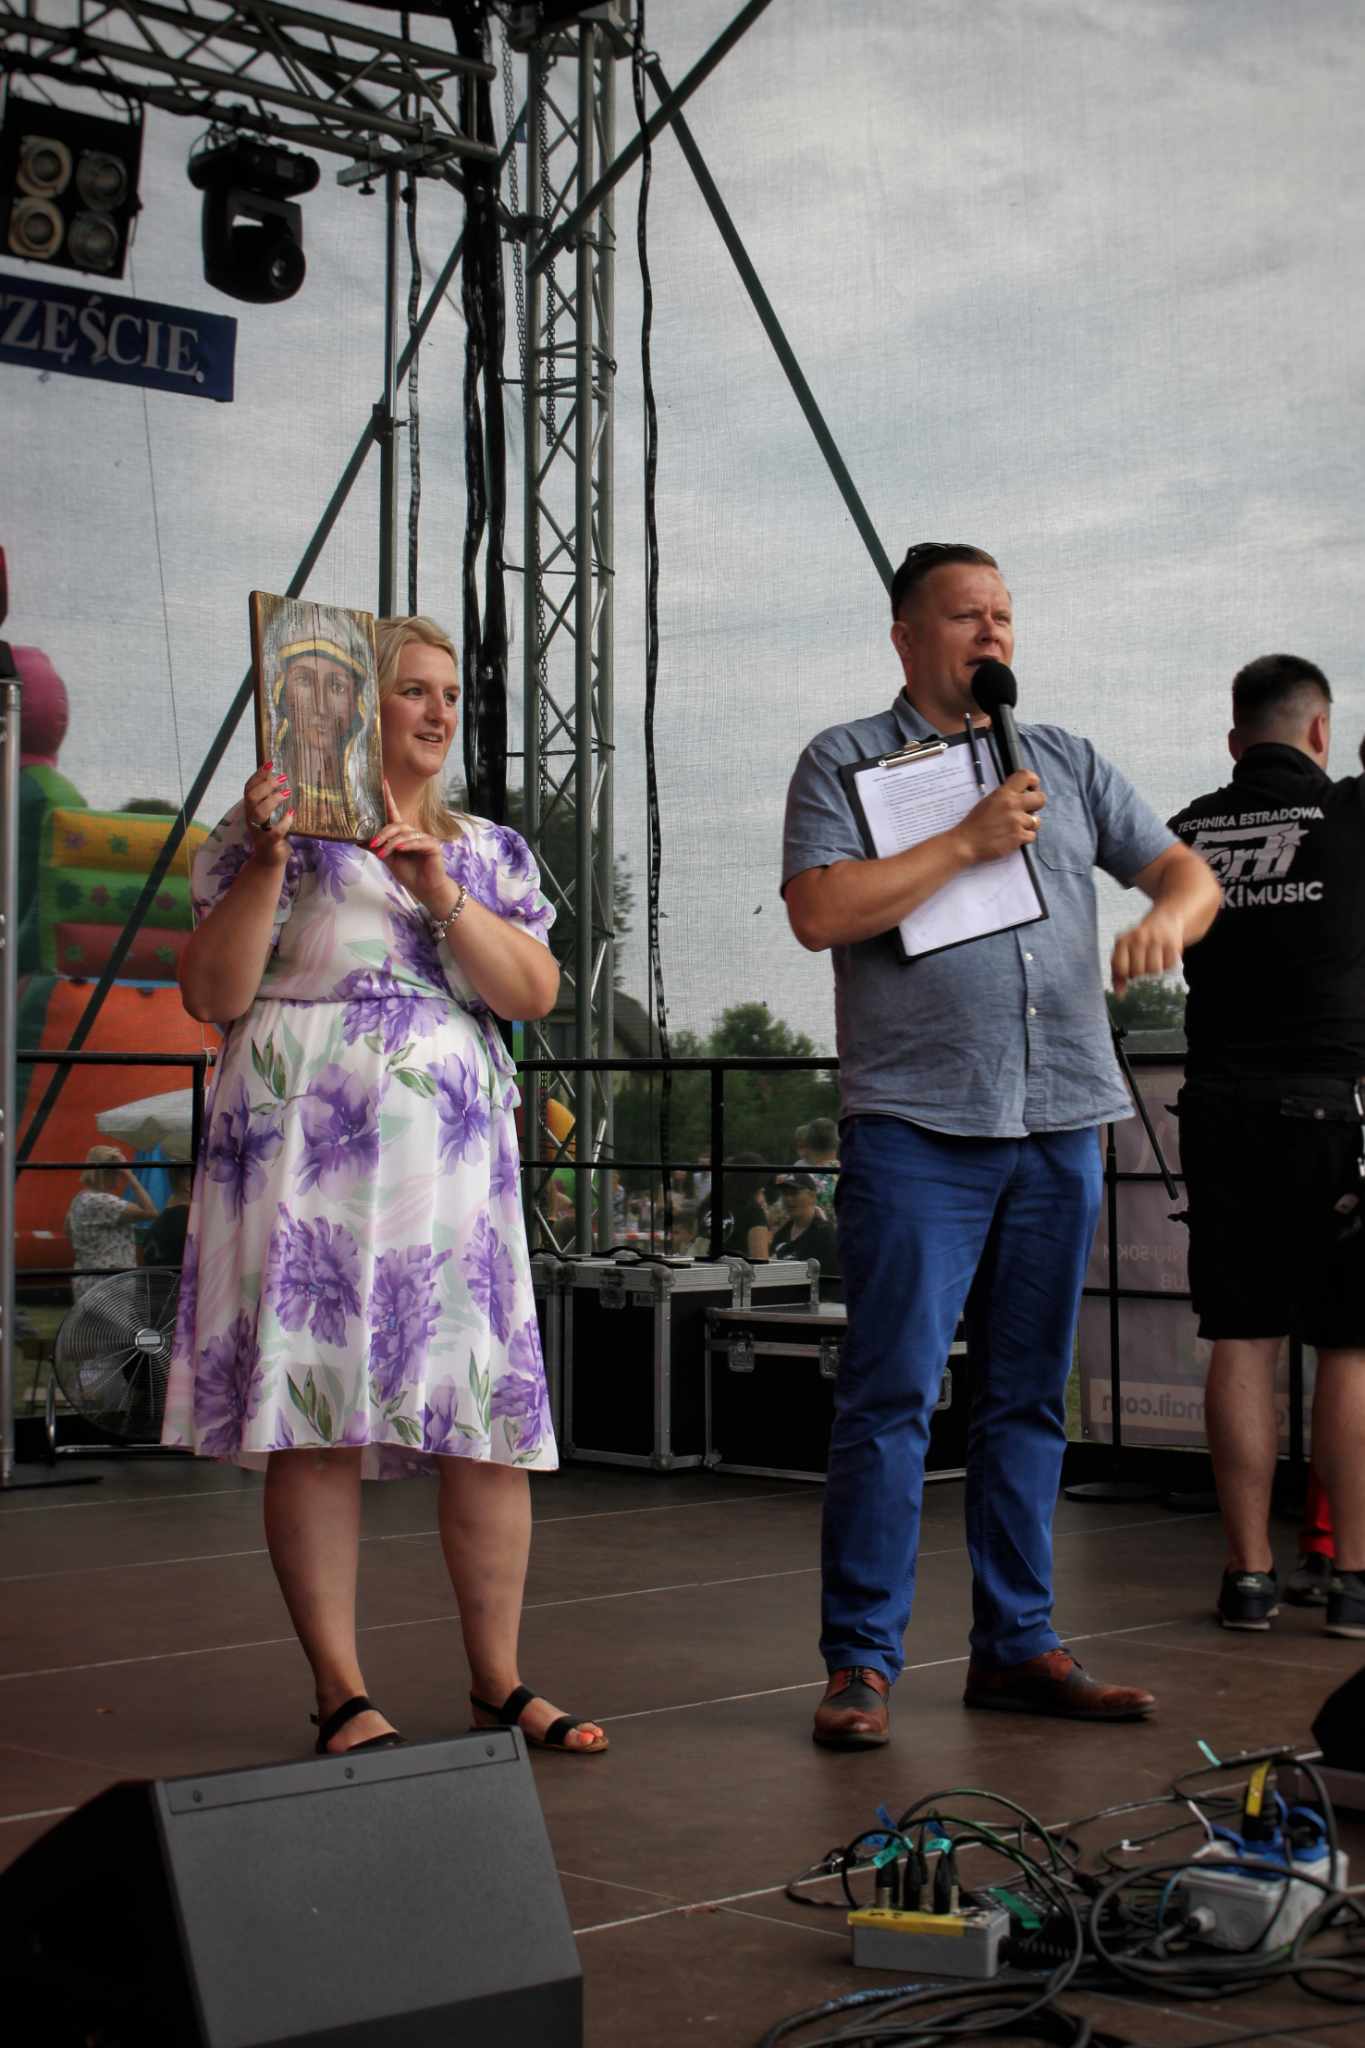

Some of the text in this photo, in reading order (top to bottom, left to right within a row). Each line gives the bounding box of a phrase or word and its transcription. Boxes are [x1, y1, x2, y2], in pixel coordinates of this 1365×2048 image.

[0, 294, 199, 378] ZĘŚCIE
[1177, 806, 1325, 833] TECHNIKA ESTRADOWA
[1246, 880, 1324, 907] MUSIC
